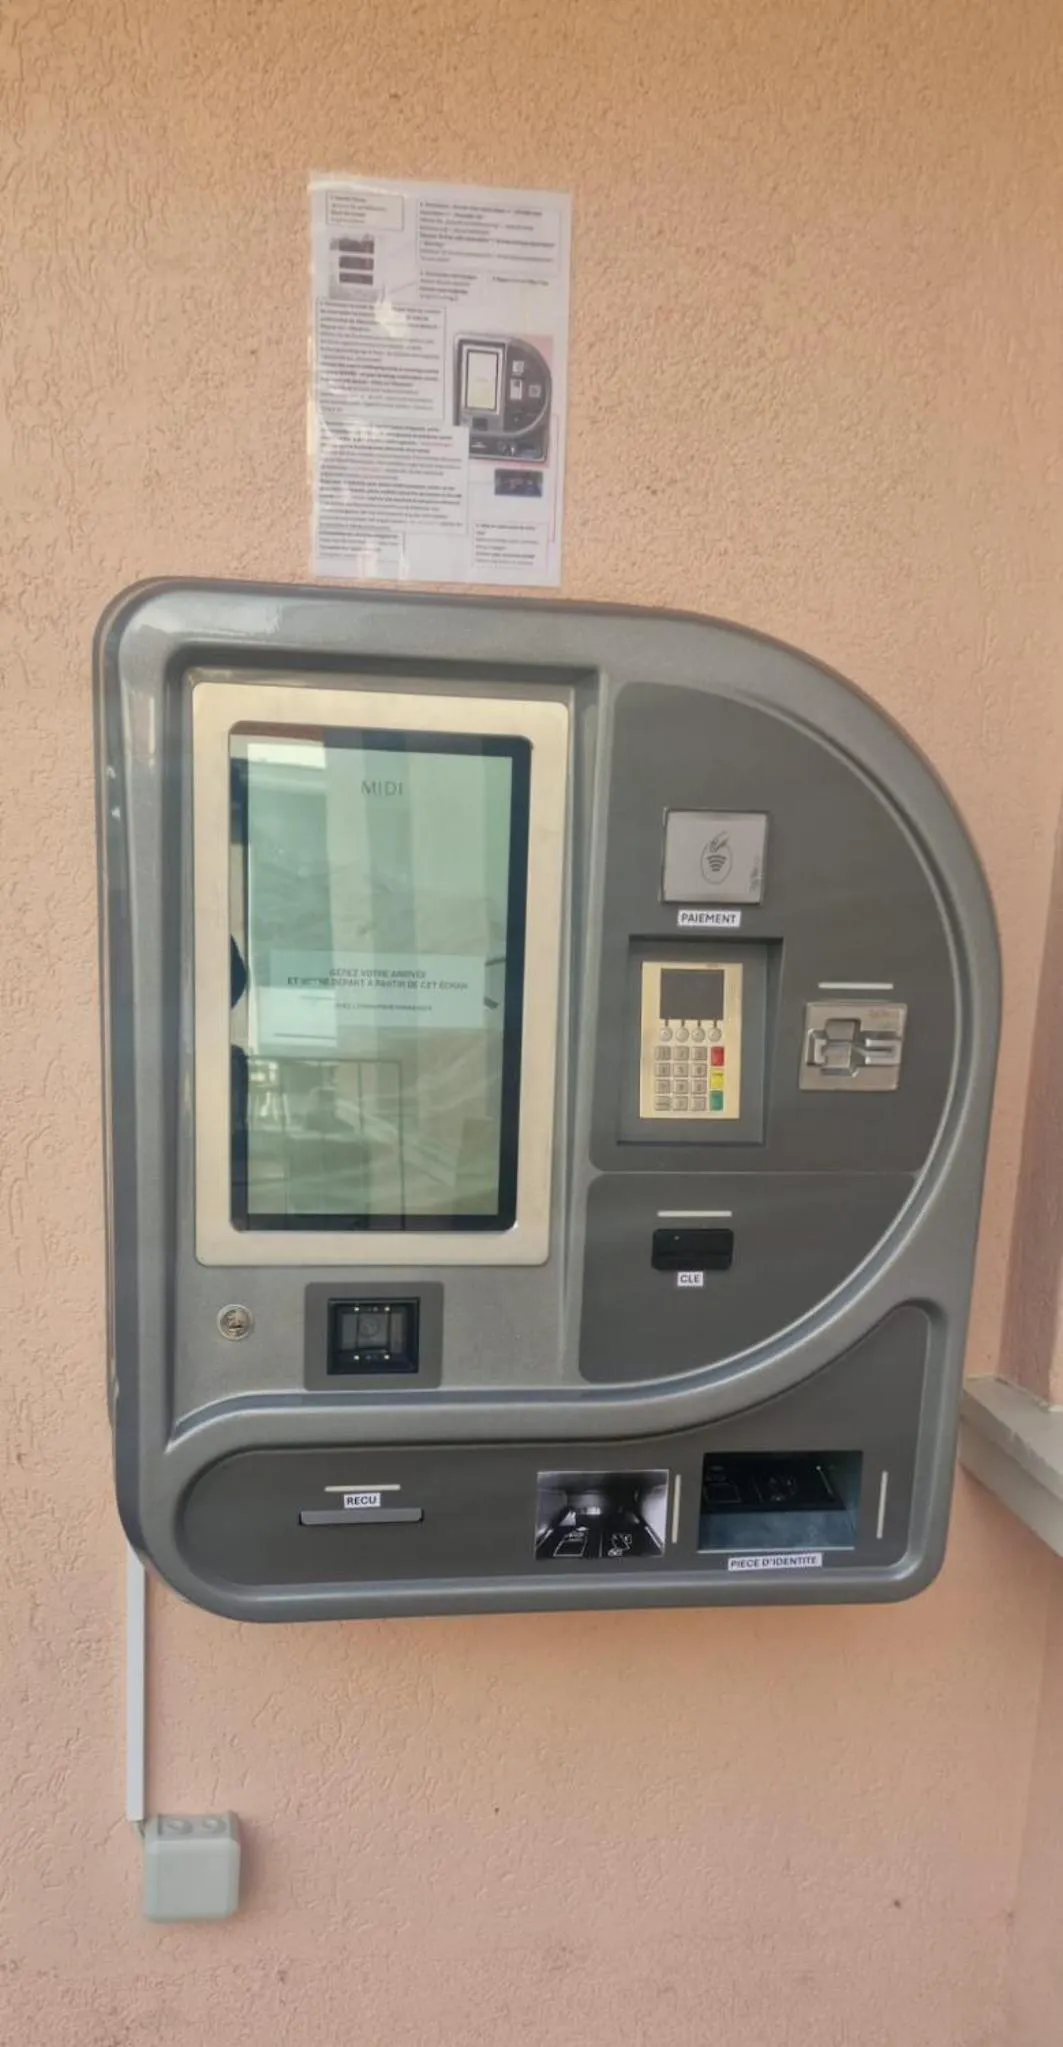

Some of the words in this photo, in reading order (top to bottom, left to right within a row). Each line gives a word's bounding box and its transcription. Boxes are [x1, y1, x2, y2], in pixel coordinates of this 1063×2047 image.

[361, 780, 403, 796] MIDI
[681, 912, 737, 924] PAIEMENT
[680, 1274, 701, 1284] CLE
[347, 1495, 377, 1505] RECU
[731, 1558, 760, 1569] PIECE
[763, 1555, 816, 1567] D'IDENTITE
